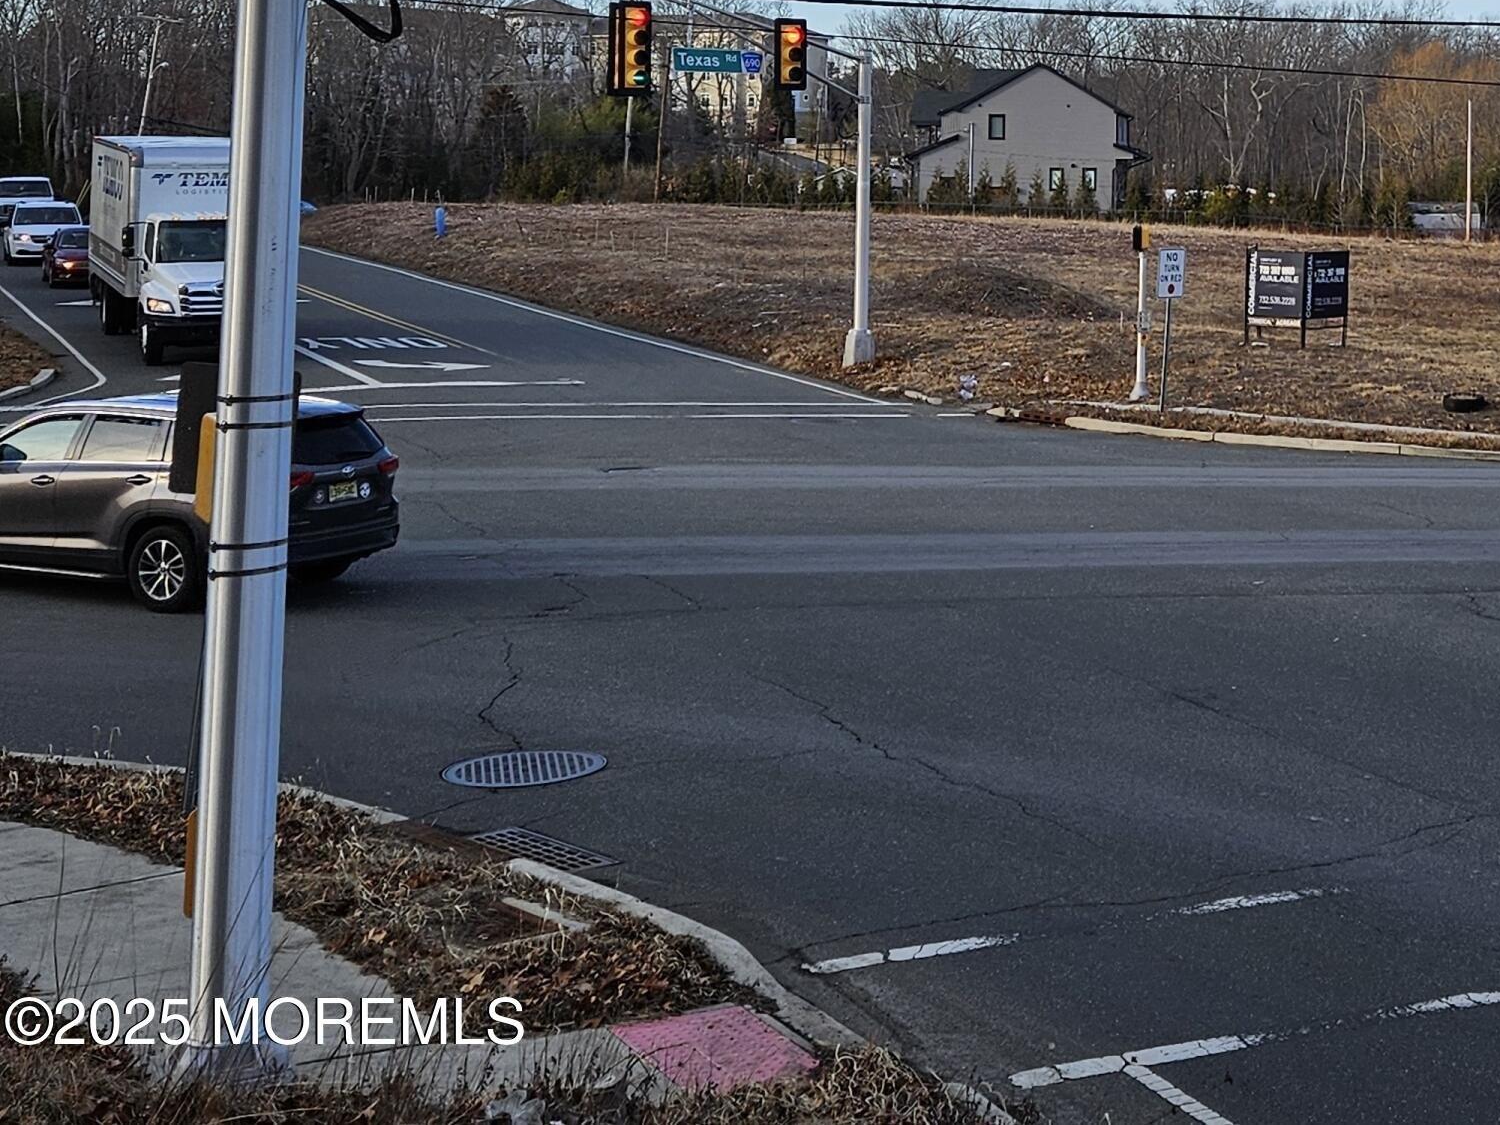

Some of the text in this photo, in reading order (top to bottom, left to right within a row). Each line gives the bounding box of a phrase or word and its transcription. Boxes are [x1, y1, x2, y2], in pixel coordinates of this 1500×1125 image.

[677, 52, 737, 67] Texas Rd
[178, 172, 229, 187] TEM
[1166, 252, 1178, 262] NO
[1164, 264, 1180, 273] TURN
[1247, 250, 1258, 316] COMMERCIAL
[1259, 274, 1300, 284] AVAILABLE
[1305, 254, 1314, 319] COMMERCIAL
[299, 336, 449, 350] ONLY
